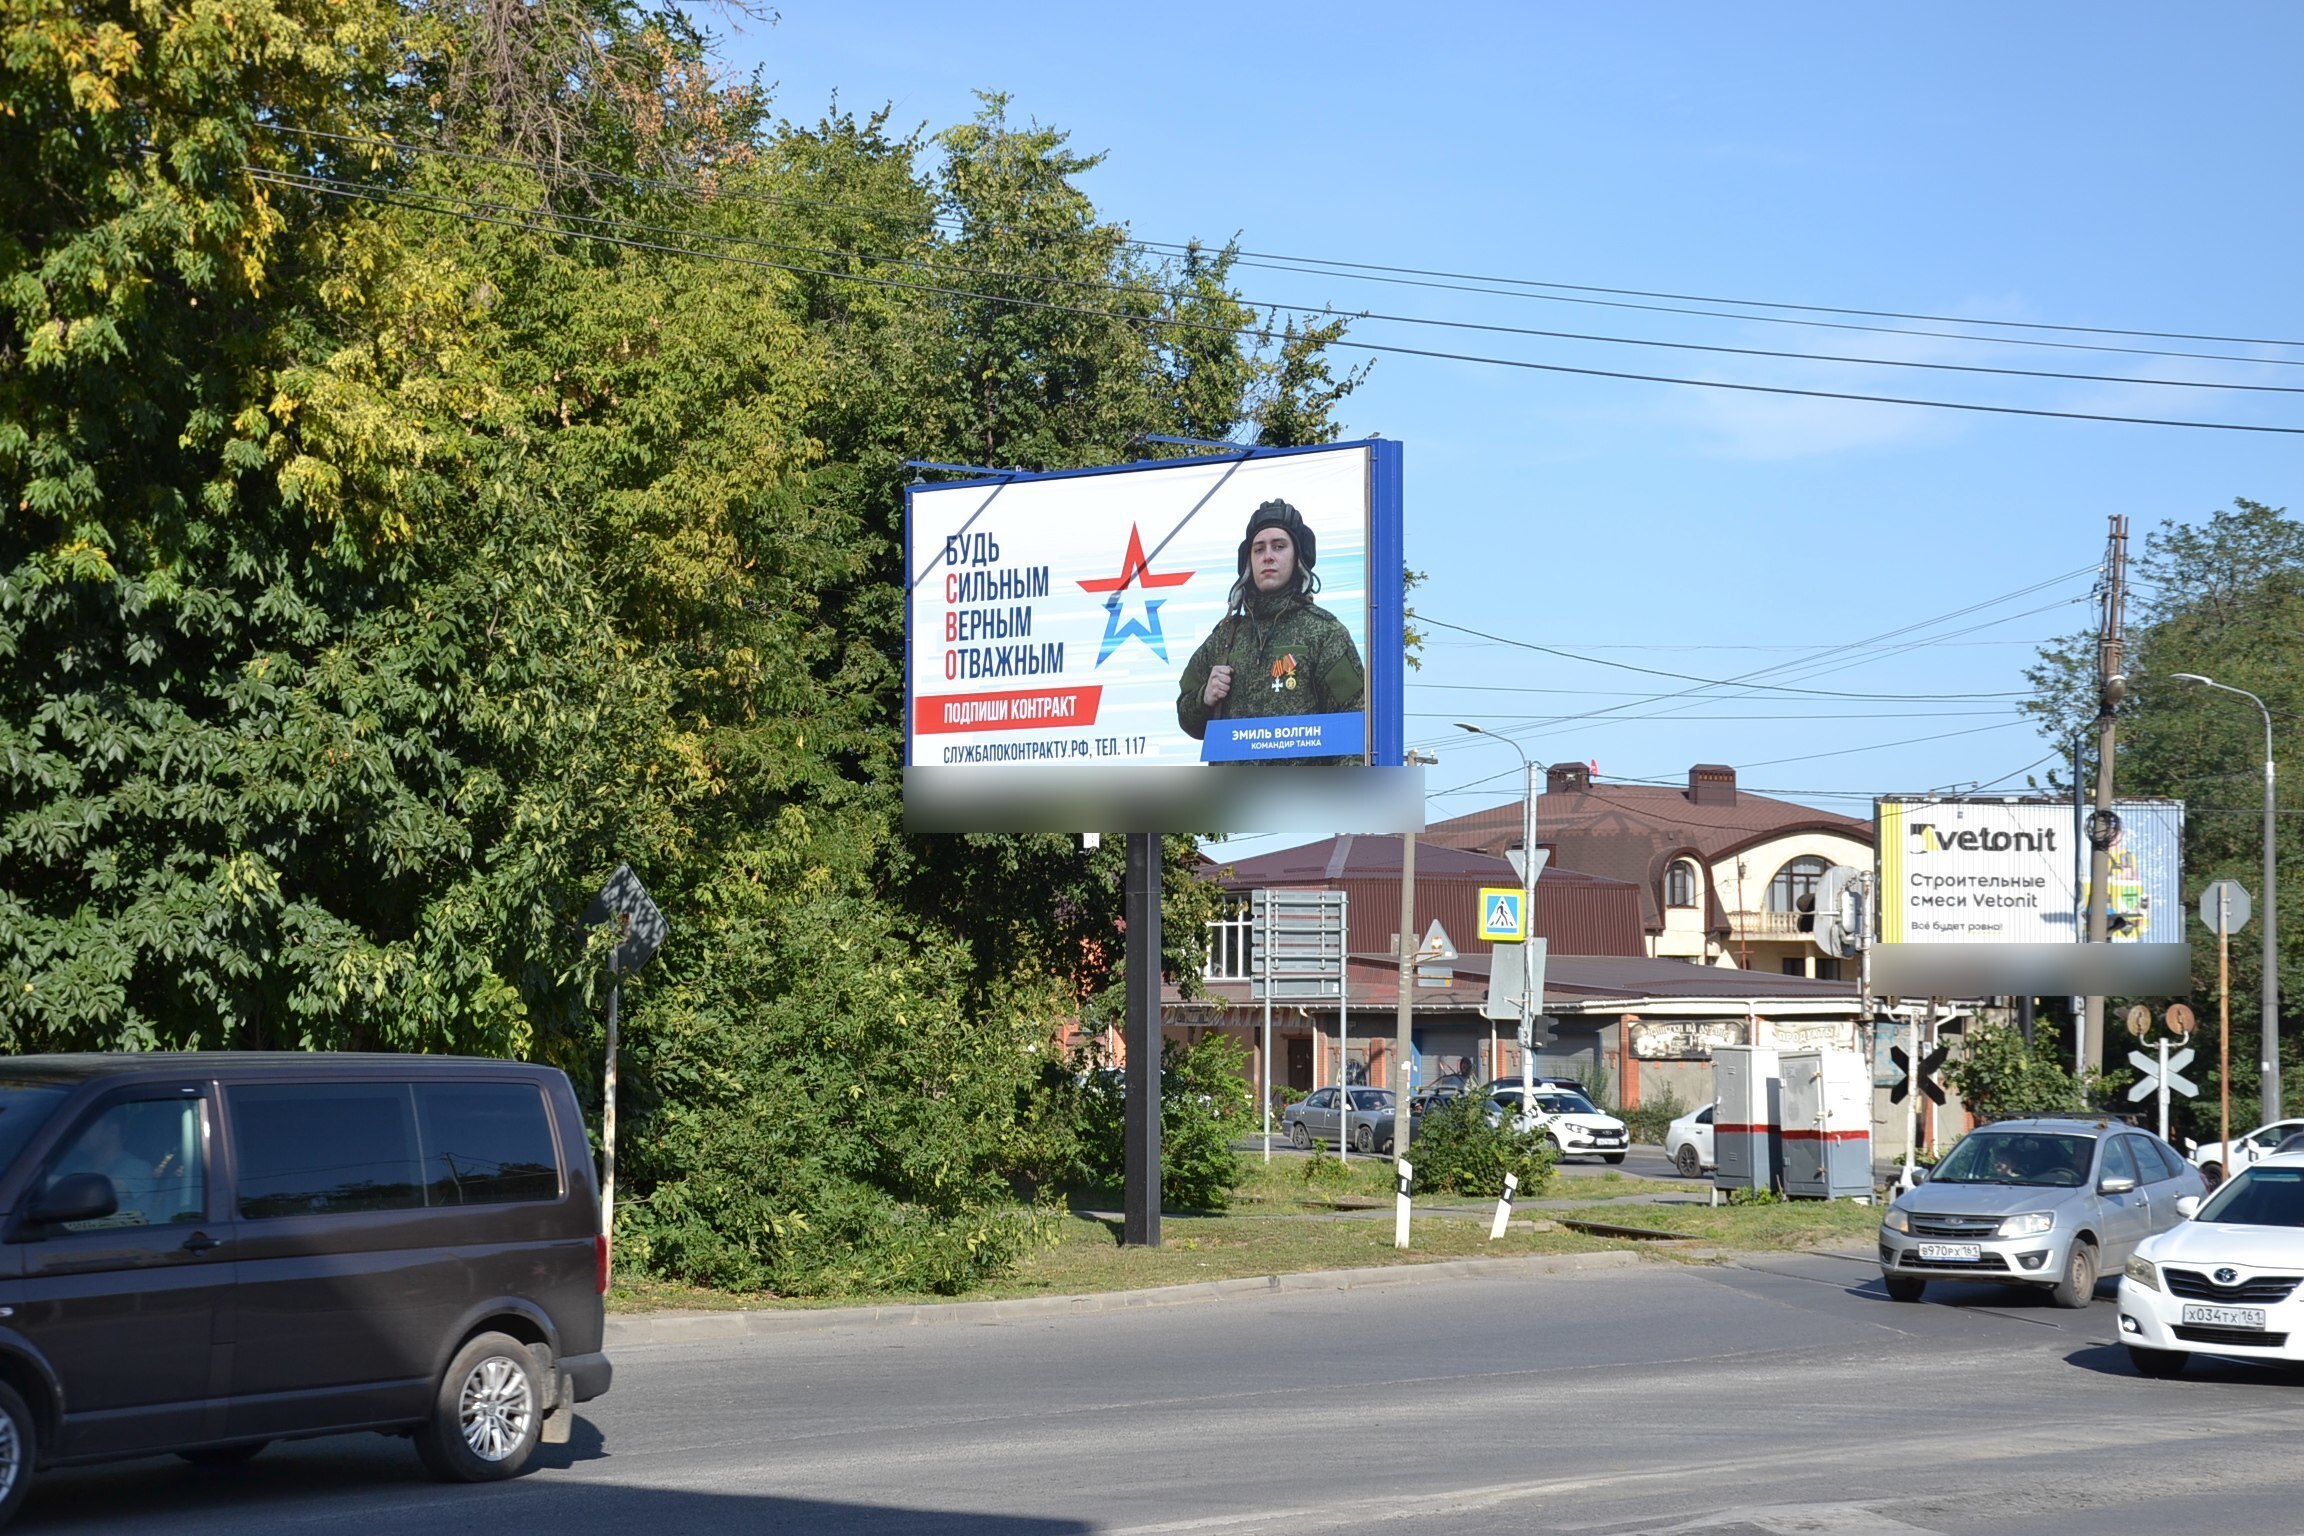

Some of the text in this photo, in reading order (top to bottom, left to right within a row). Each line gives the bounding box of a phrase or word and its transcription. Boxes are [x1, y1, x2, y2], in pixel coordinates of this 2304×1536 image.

[946, 531, 1000, 568] БУДЬ
[946, 565, 1049, 604] СИЛЬНЫМ
[945, 605, 1032, 642] ВЕРНЫМ
[945, 641, 1064, 681] ОТВАЖНЫМ
[943, 695, 1077, 725] ПОДПИШИ КОНТРАКТ
[1231, 725, 1322, 741] ЭМИЛЬ ВОЛГИН
[1251, 738, 1322, 751] КОМАНДИР ТАНКА
[943, 736, 1147, 764] СЛУЖБАПОКОНТРАКТУ.РФ, ТЕЛ. 117
[1934, 826, 2058, 852] vetonit
[1910, 872, 2046, 890] Строительные
[1910, 892, 2038, 909] смеси Vetonit
